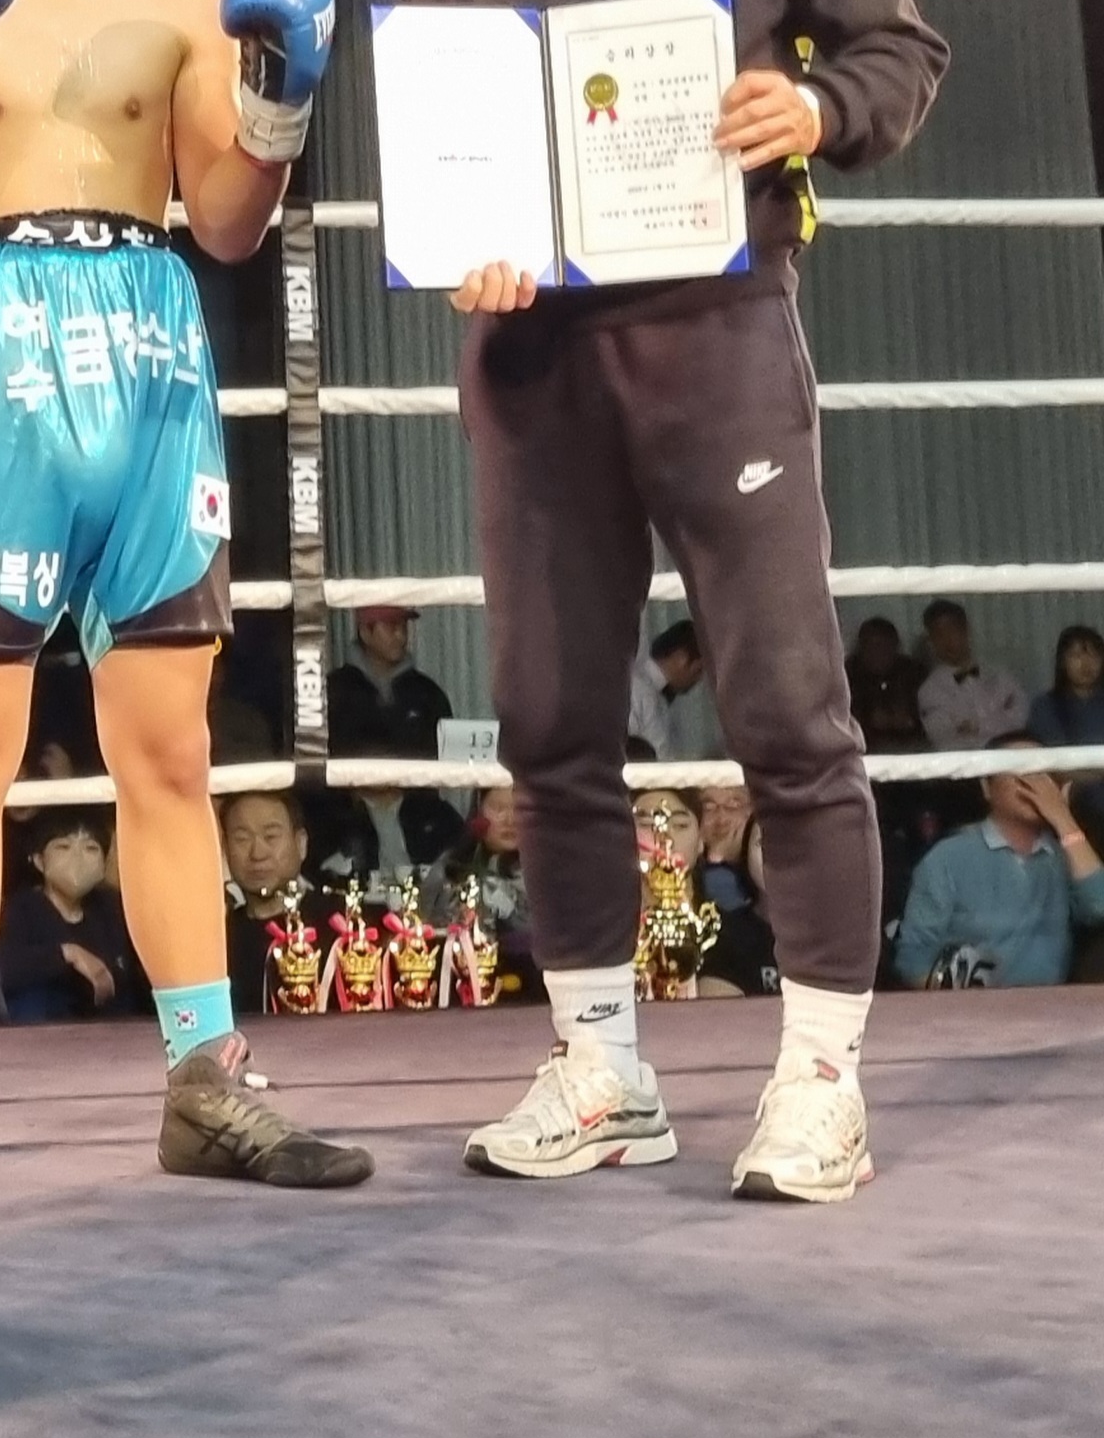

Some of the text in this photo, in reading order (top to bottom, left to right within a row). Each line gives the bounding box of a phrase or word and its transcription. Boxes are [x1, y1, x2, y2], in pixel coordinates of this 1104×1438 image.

[286, 266, 314, 341] KBM
[292, 457, 319, 533] KBM
[296, 649, 323, 727] KBM
